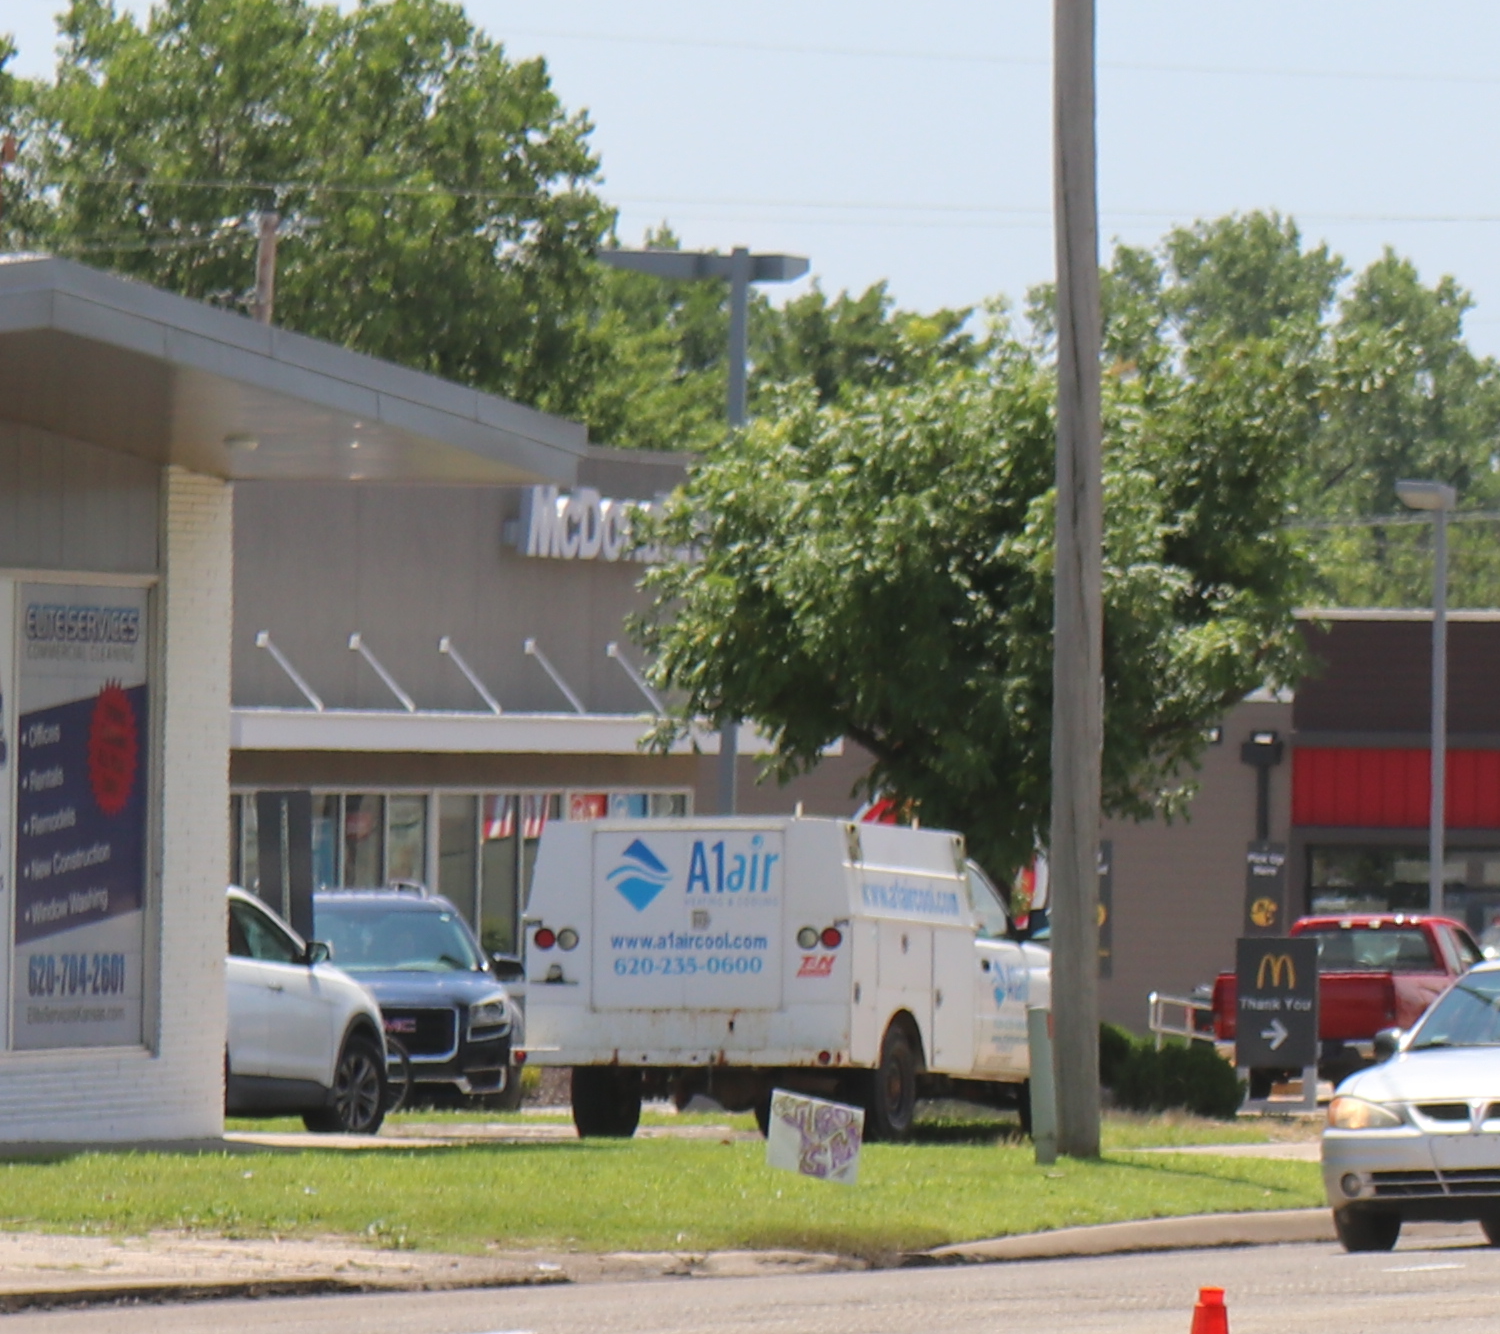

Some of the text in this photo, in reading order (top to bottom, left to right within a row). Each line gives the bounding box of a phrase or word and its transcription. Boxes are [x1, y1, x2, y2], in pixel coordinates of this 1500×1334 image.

[610, 931, 768, 950] www.a1aircool.com
[613, 956, 763, 976] 620-235-0600
[1239, 998, 1312, 1012] Thank You
